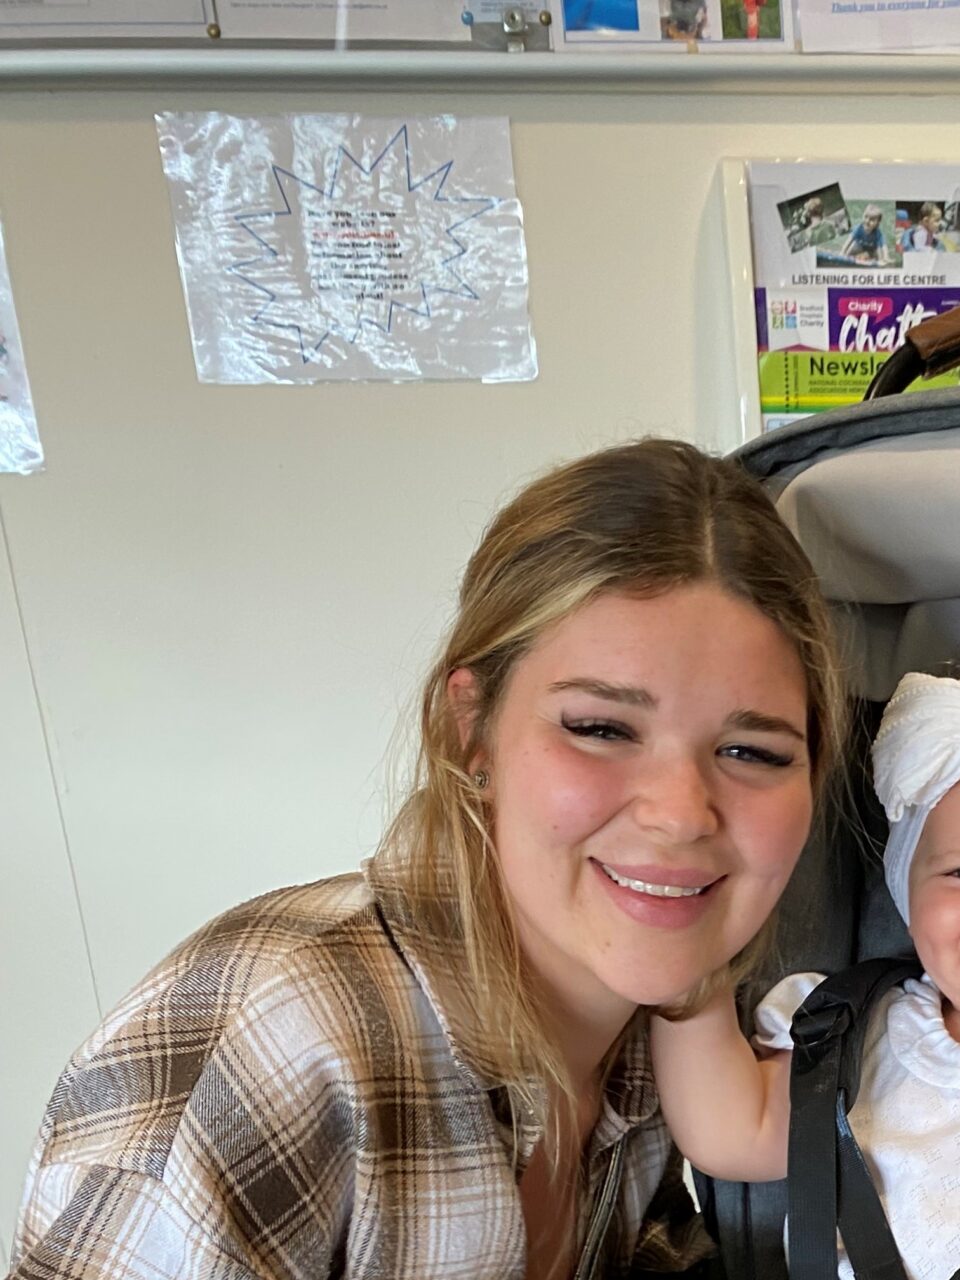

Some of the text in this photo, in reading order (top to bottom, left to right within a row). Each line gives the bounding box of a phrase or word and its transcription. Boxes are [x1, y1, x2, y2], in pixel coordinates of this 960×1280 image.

[792, 274, 946, 286] LISTENING FOR LIFE CENTRE
[848, 301, 883, 314] Charity
